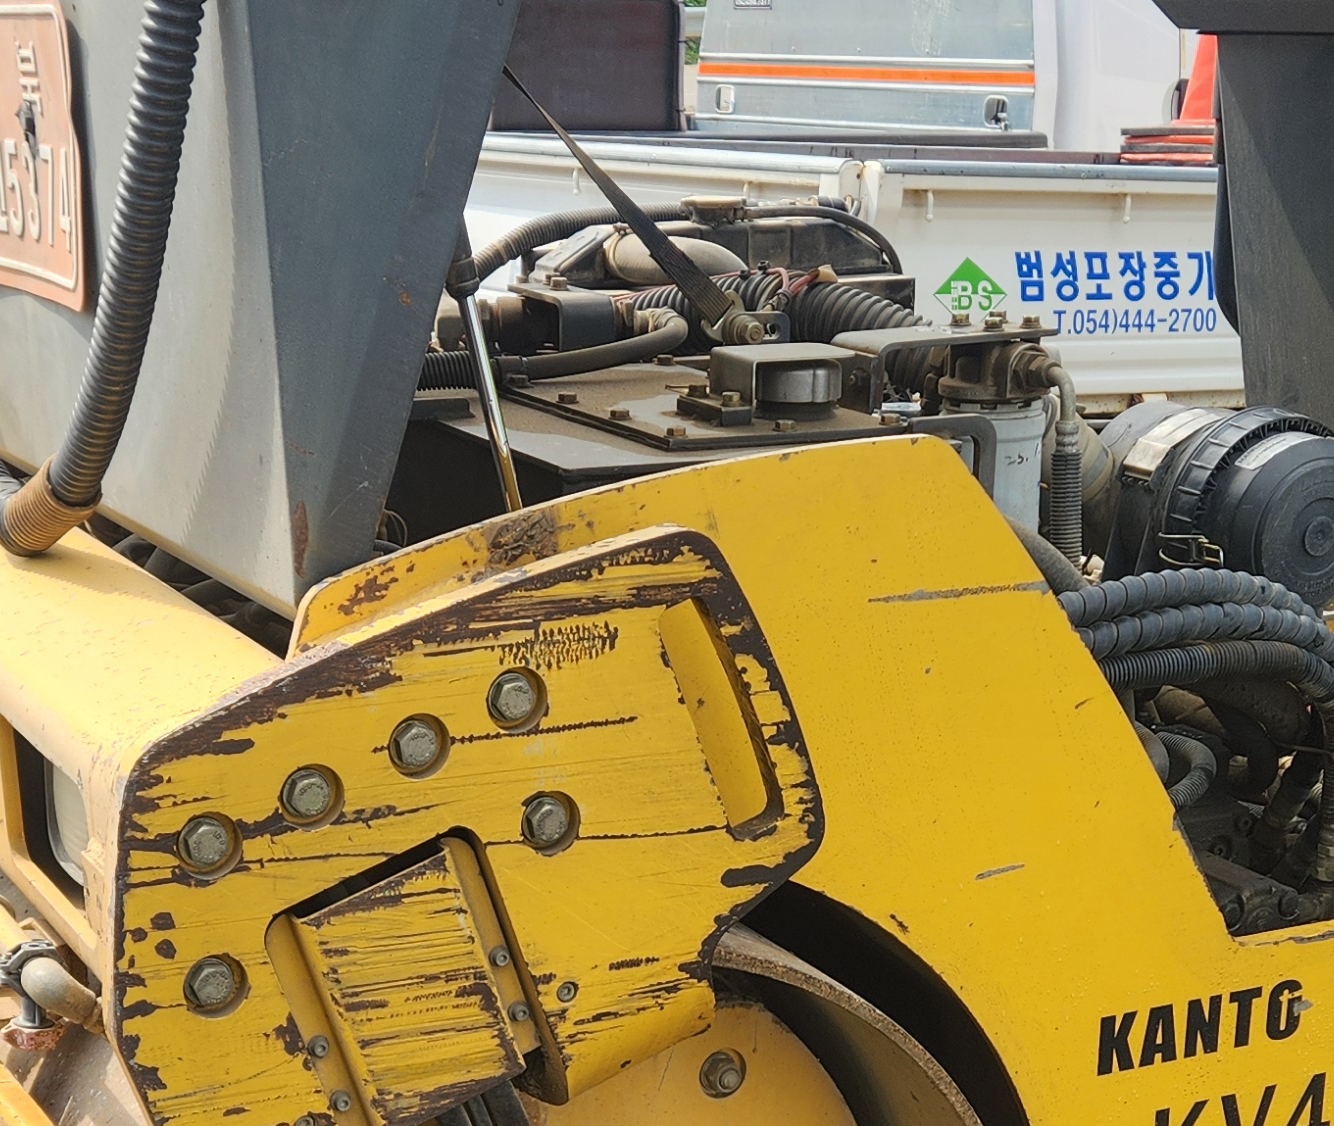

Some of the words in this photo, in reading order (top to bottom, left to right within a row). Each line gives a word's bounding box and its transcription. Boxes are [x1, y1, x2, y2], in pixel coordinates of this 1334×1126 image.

[1014, 249, 1216, 302] 범성포장중기
[1053, 307, 1217, 335] T.054)444-2700
[1096, 979, 1304, 1077] KANTO
